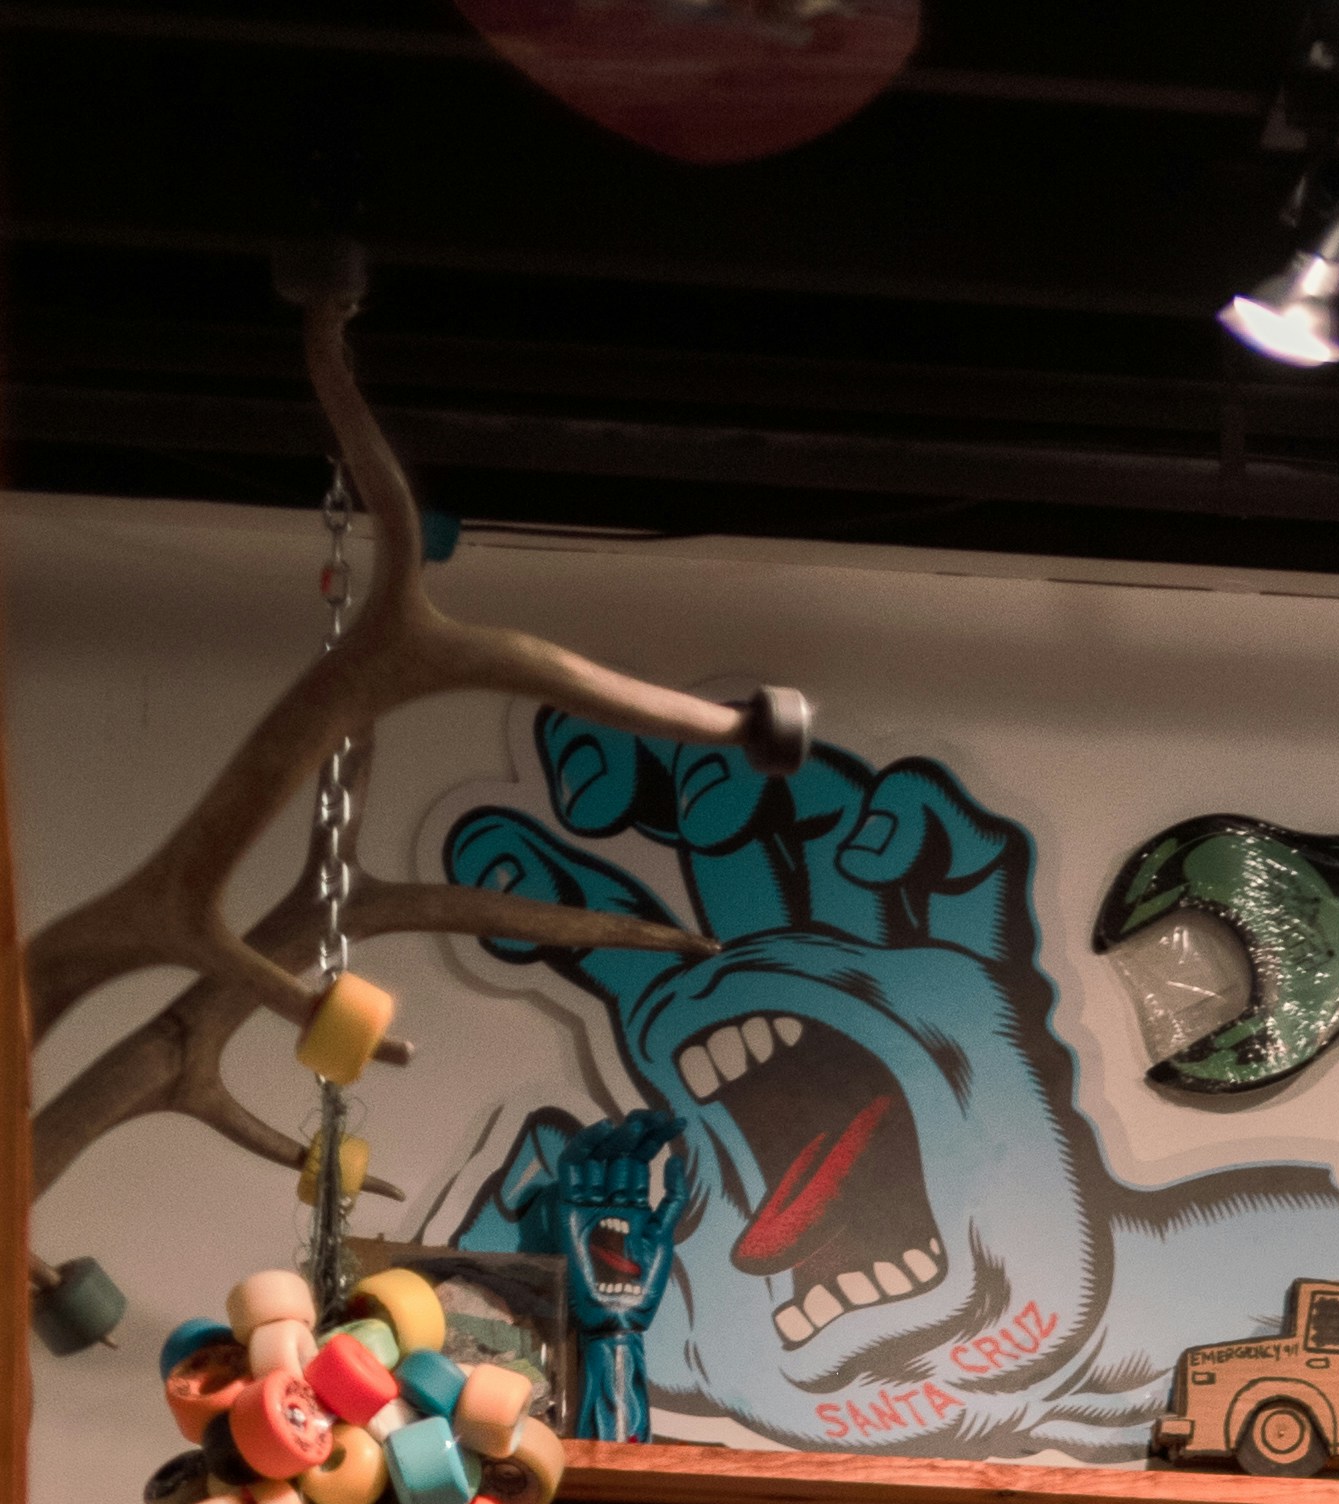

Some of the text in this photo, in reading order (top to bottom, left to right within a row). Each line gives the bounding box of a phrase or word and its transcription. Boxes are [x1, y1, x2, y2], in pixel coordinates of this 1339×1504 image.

[950, 1300, 1059, 1374] CRUZ
[1189, 1342, 1282, 1367] EMERGENCY
[815, 1381, 966, 1438] SANTA
